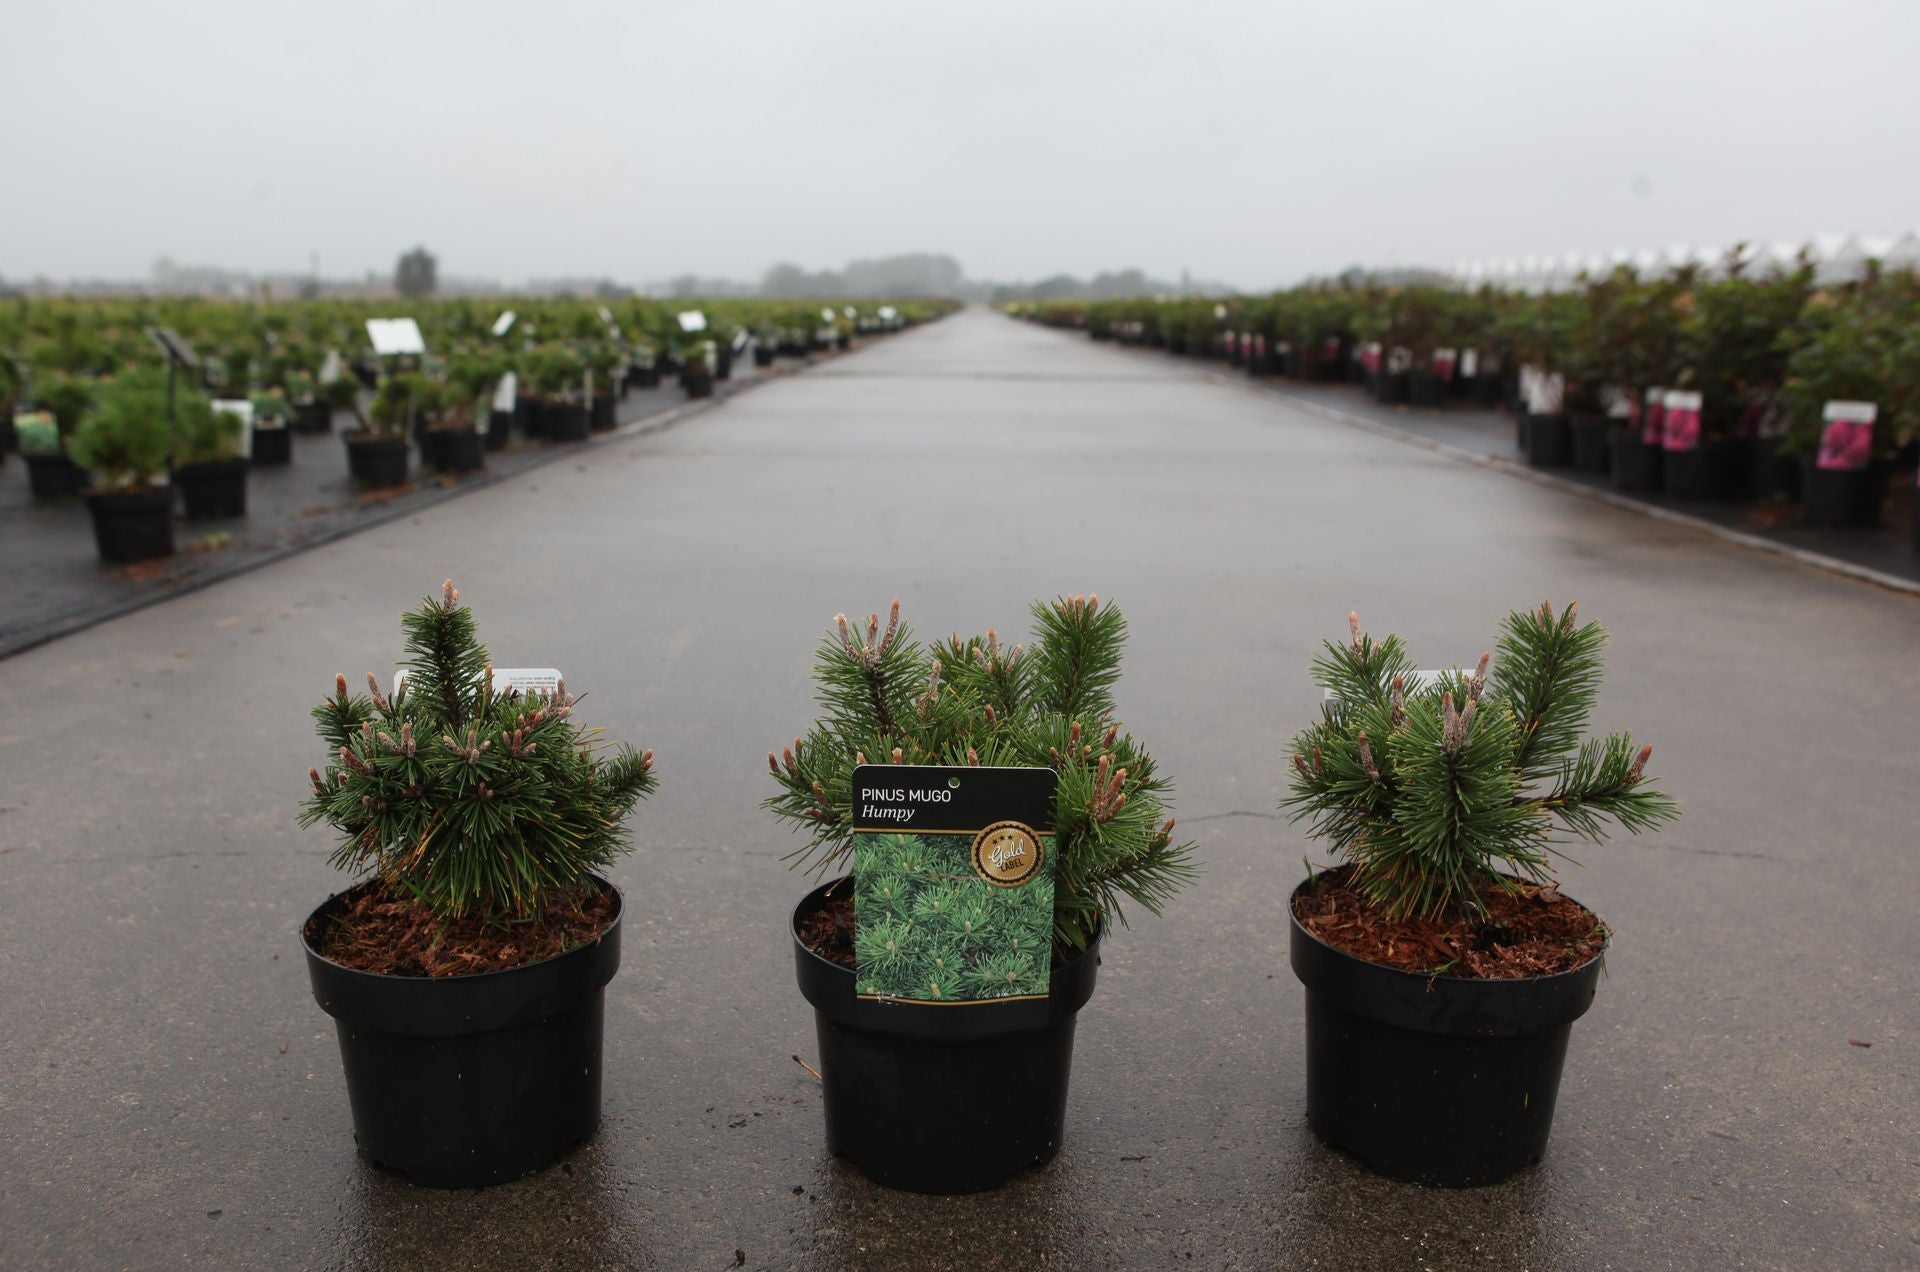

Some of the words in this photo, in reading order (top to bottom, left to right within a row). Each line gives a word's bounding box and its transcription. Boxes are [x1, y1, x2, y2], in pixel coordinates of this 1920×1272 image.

[862, 788, 905, 802] PINUS
[909, 789, 951, 803] MUGO
[861, 805, 915, 821] Humpy
[988, 839, 1027, 867] Gold
[1000, 859, 1024, 872] LABEL
